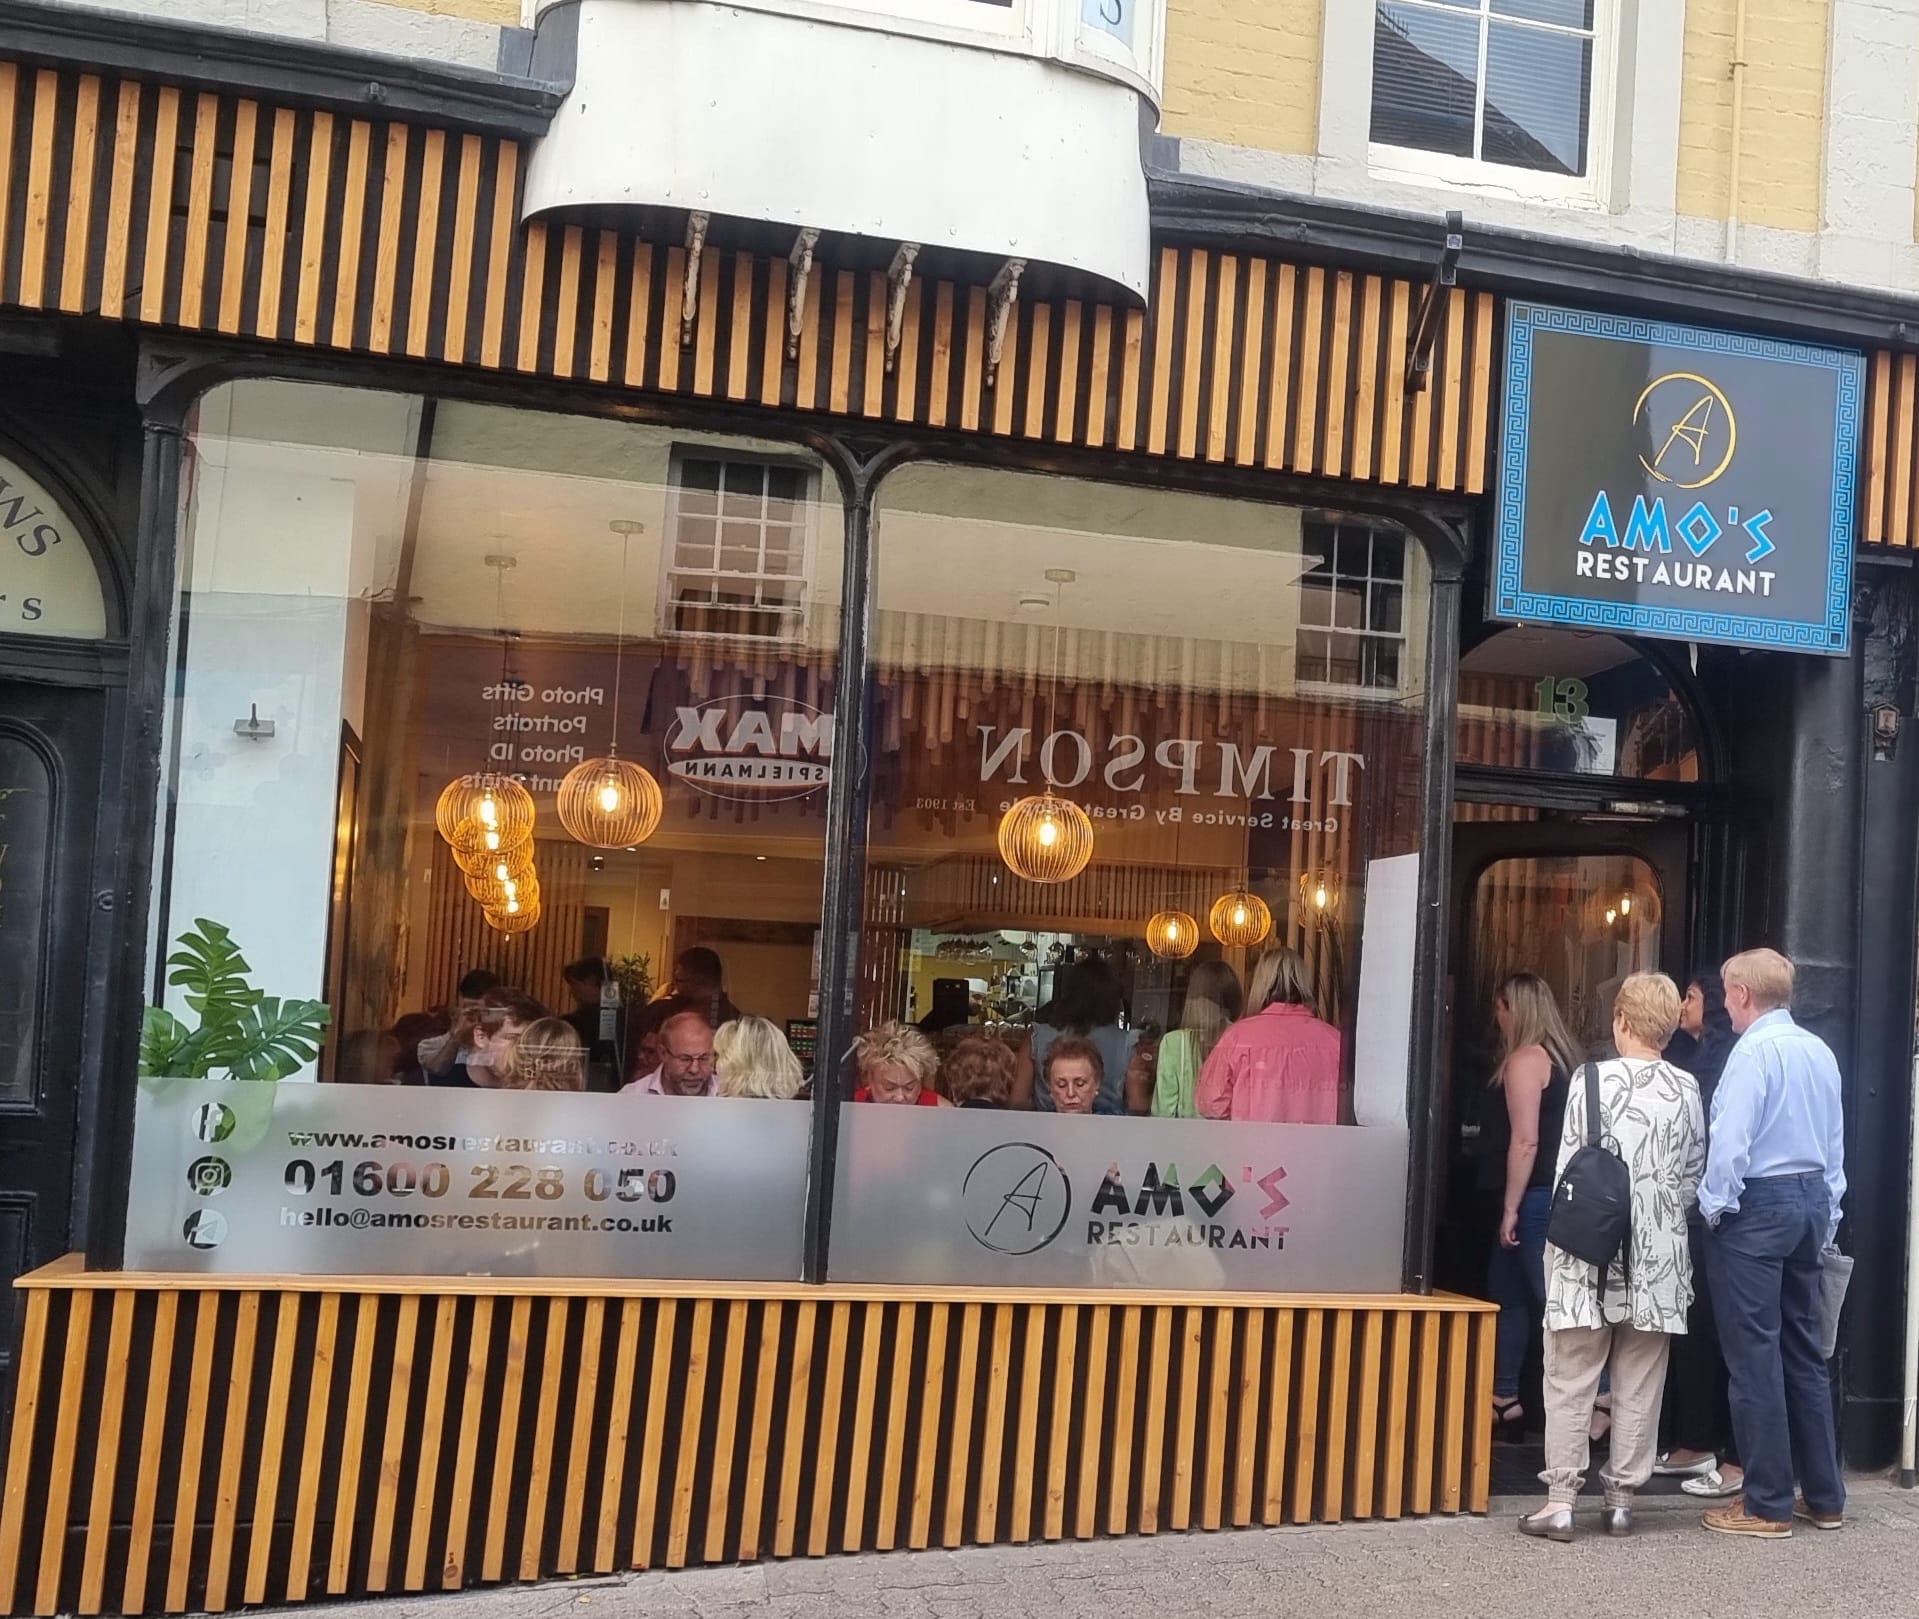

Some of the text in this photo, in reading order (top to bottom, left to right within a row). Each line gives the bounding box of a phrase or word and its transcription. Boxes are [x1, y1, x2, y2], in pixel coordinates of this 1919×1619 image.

[1578, 490, 1776, 564] AMO'S
[1575, 551, 1776, 597] RESTAURANT
[1534, 676, 1590, 725] 13
[284, 1159, 676, 1203] 01600 228 050
[1091, 1162, 1291, 1220] AMO'S
[280, 1207, 673, 1233] hello@amosrestaurant.co.uk
[1086, 1220, 1291, 1251] RESTAURANT
